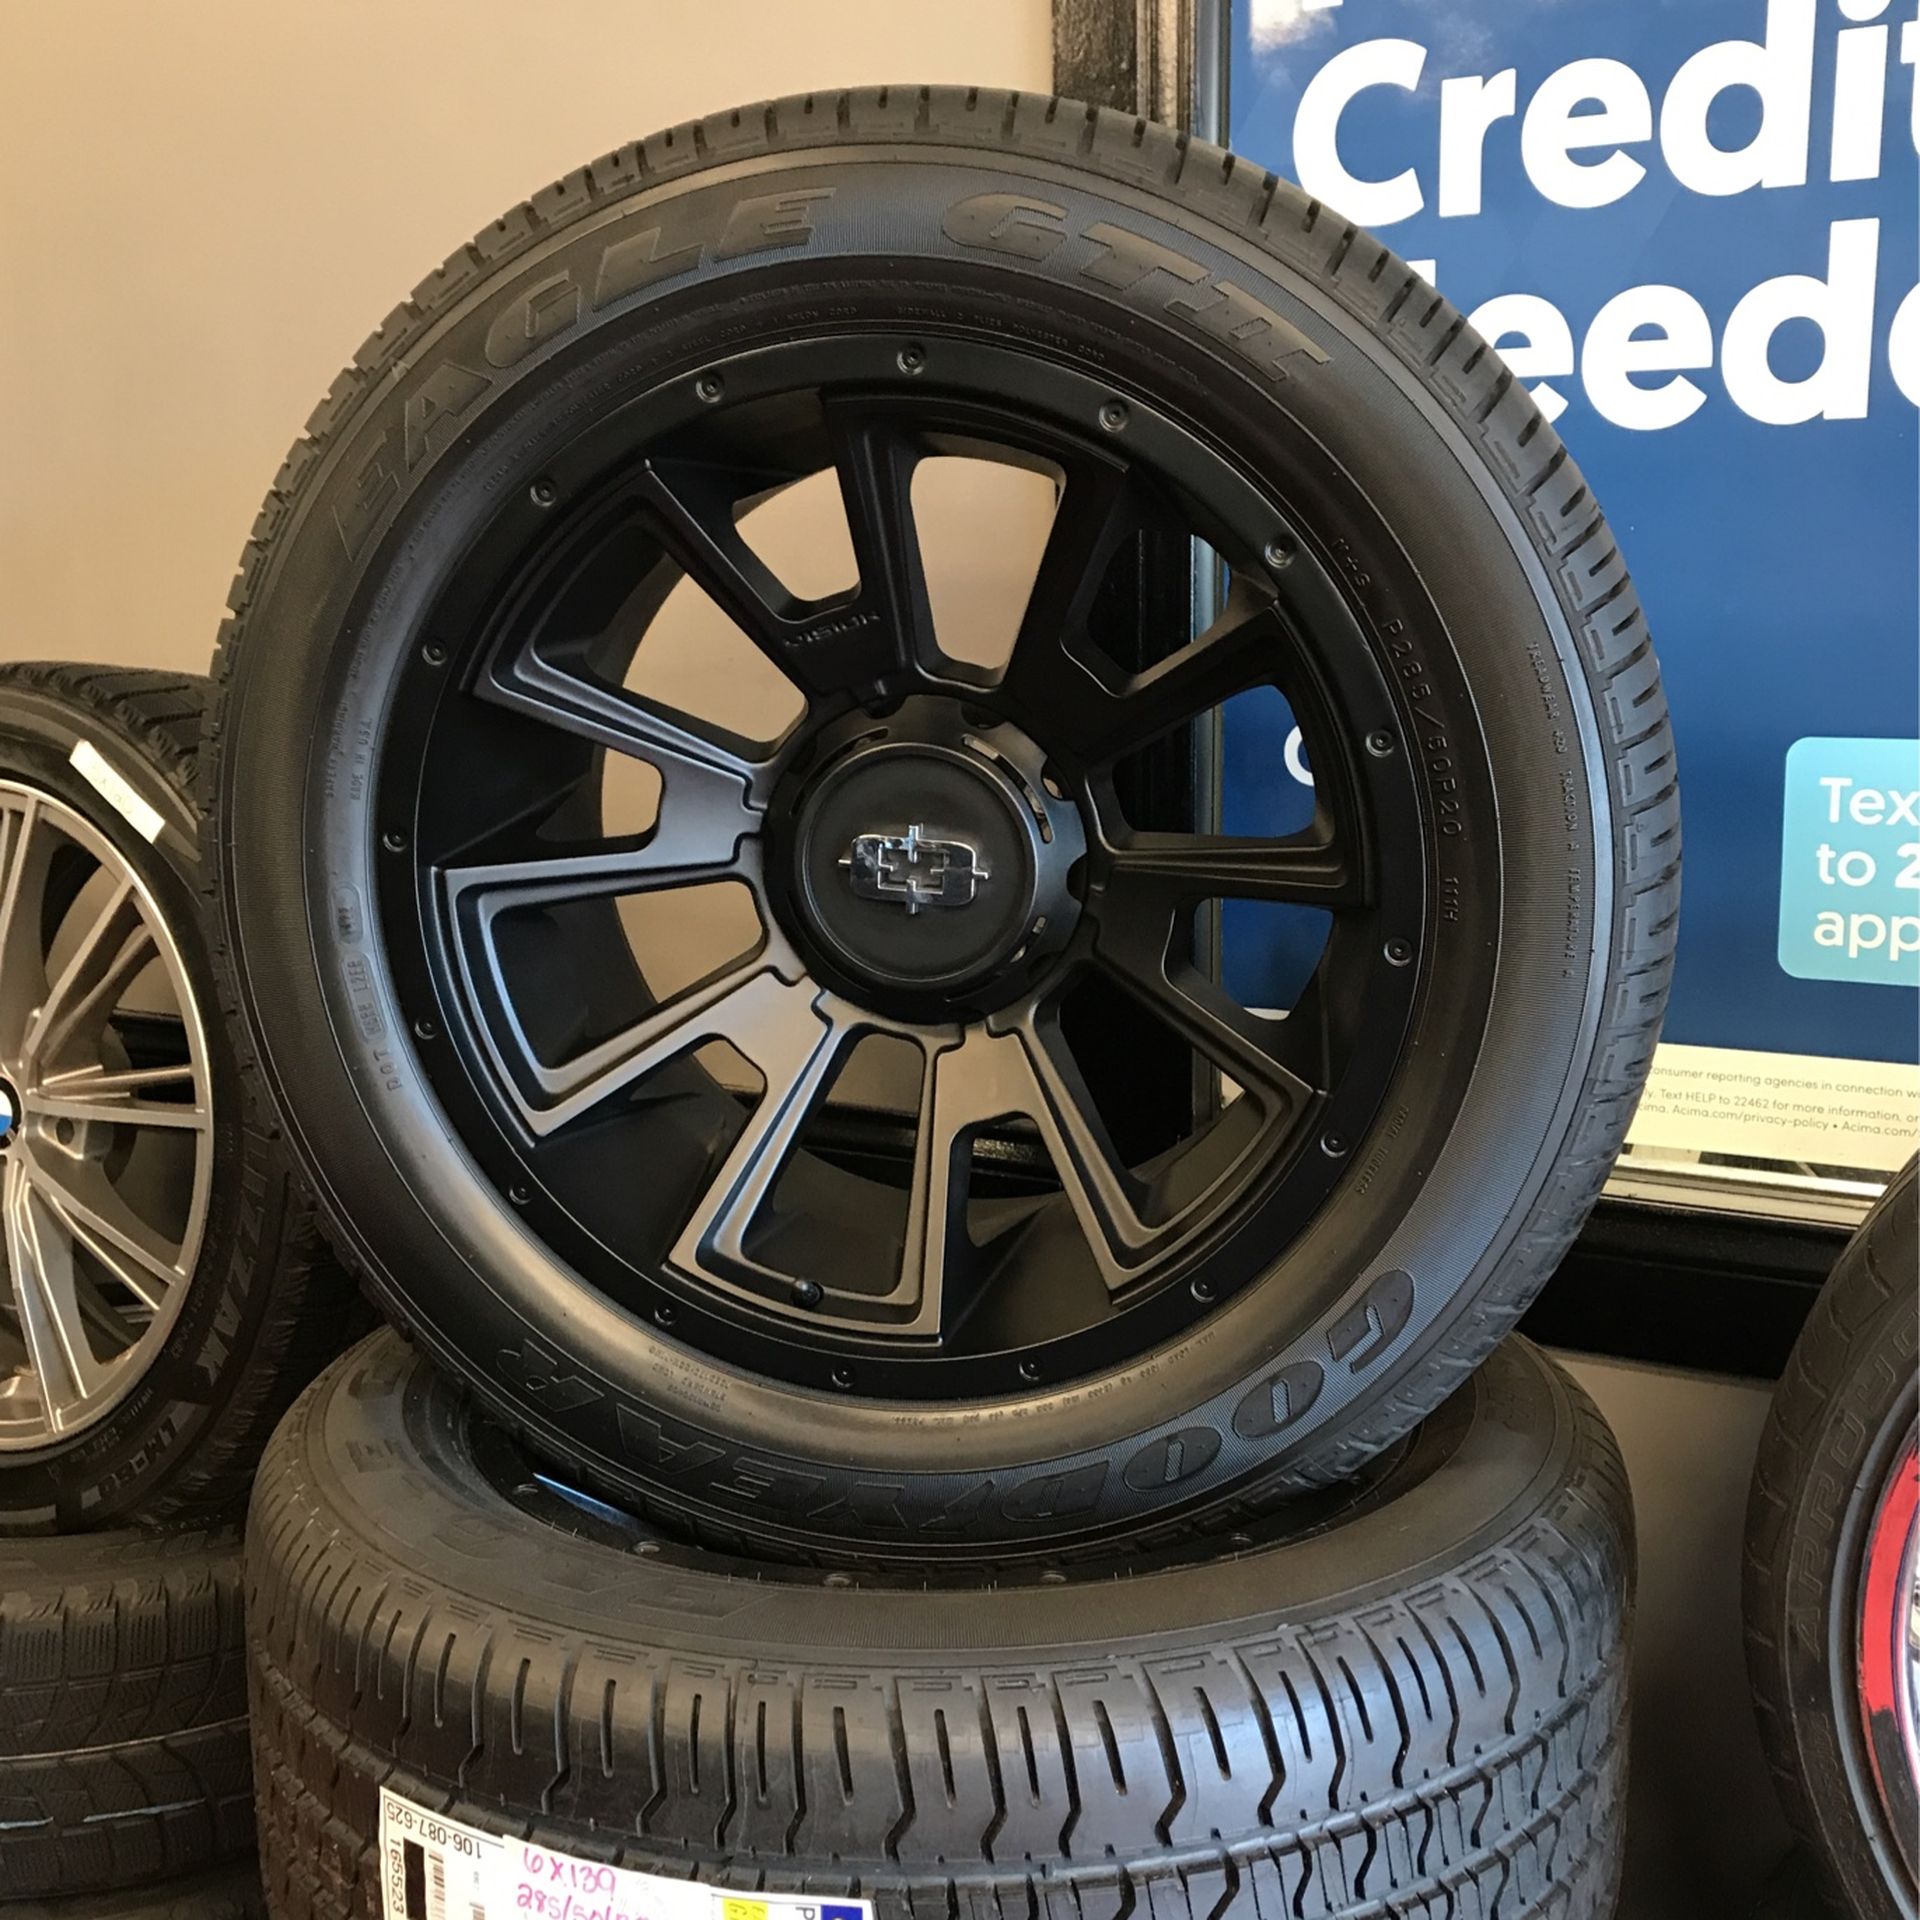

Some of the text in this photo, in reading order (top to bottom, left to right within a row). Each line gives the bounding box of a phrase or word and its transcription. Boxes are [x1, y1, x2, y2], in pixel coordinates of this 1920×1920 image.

[1408, 217, 1919, 431] eed
[333, 187, 837, 562] EAGLE
[1816, 843, 1877, 887] to
[1650, 1067, 1704, 1079] onsumer
[1706, 1071, 1761, 1087] reporting
[1764, 1077, 1818, 1090] agencies
[1821, 1080, 1833, 1091] in
[1835, 1082, 1903, 1098] connection
[1661, 1088, 1683, 1101] Text
[1685, 1091, 1717, 1104] HELP
[1719, 1095, 1731, 1106] to
[1734, 1095, 1770, 1110] 22462
[1772, 1099, 1790, 1111] for
[1792, 1102, 1825, 1115] more
[1672, 1104, 1829, 1131] Acima.com/privacy-policy
[1841, 1121, 1919, 1139] Acima.com/
[496, 1269, 1416, 1536] GOODYEAR
